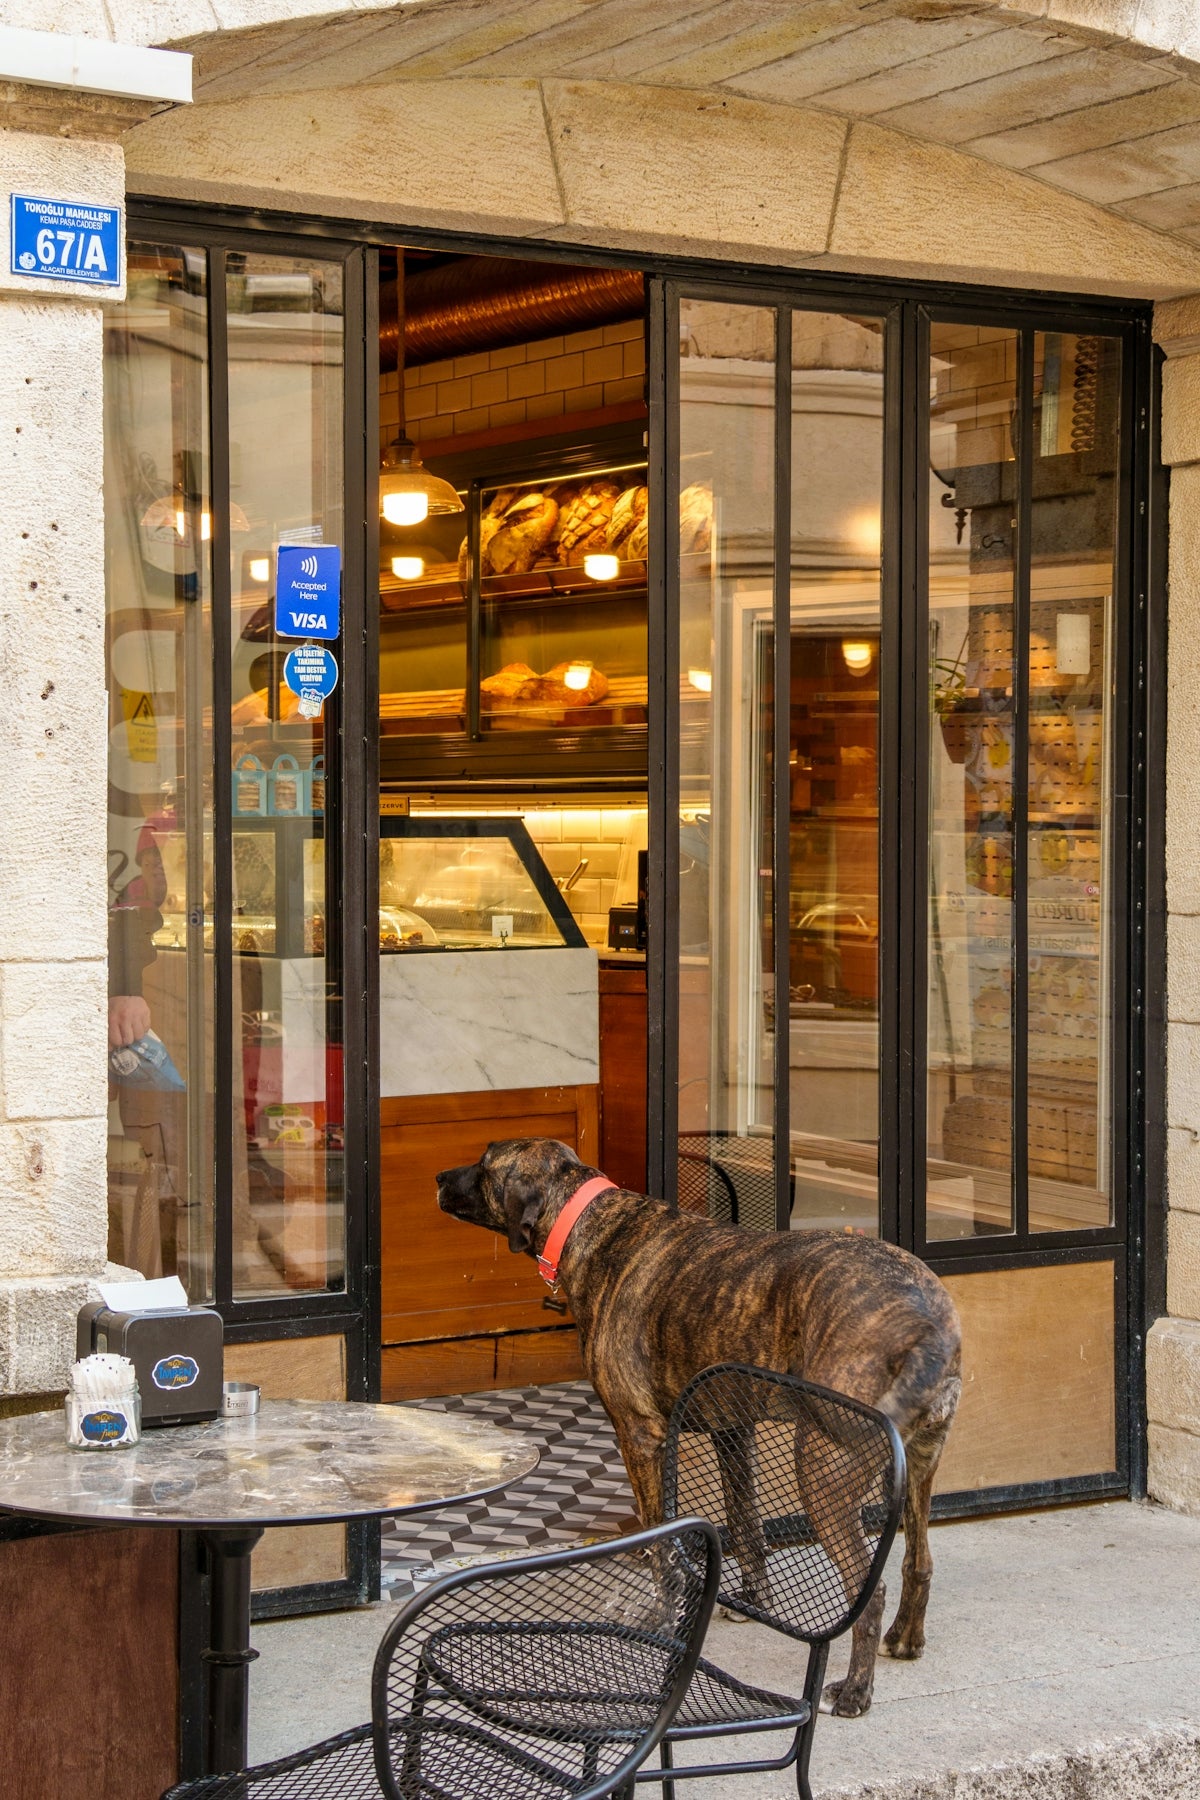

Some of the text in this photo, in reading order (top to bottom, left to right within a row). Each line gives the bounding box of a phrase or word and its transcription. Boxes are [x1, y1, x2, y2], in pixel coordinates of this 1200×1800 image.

[24, 201, 112, 223] TOKOĞLU MAHALLESİ
[59, 218, 76, 229] PAŞA
[76, 219, 103, 230] CADDESİ
[36, 228, 108, 272] 67/A
[40, 265, 100, 278] ALAÇATI BELEDİYESİ
[291, 580, 327, 591] Accepted
[299, 591, 318, 600] Here
[289, 612, 328, 630] VISA
[303, 649, 325, 658] İŞLETME
[307, 666, 327, 674] DESTEK
[299, 674, 323, 682] VERİYOR
